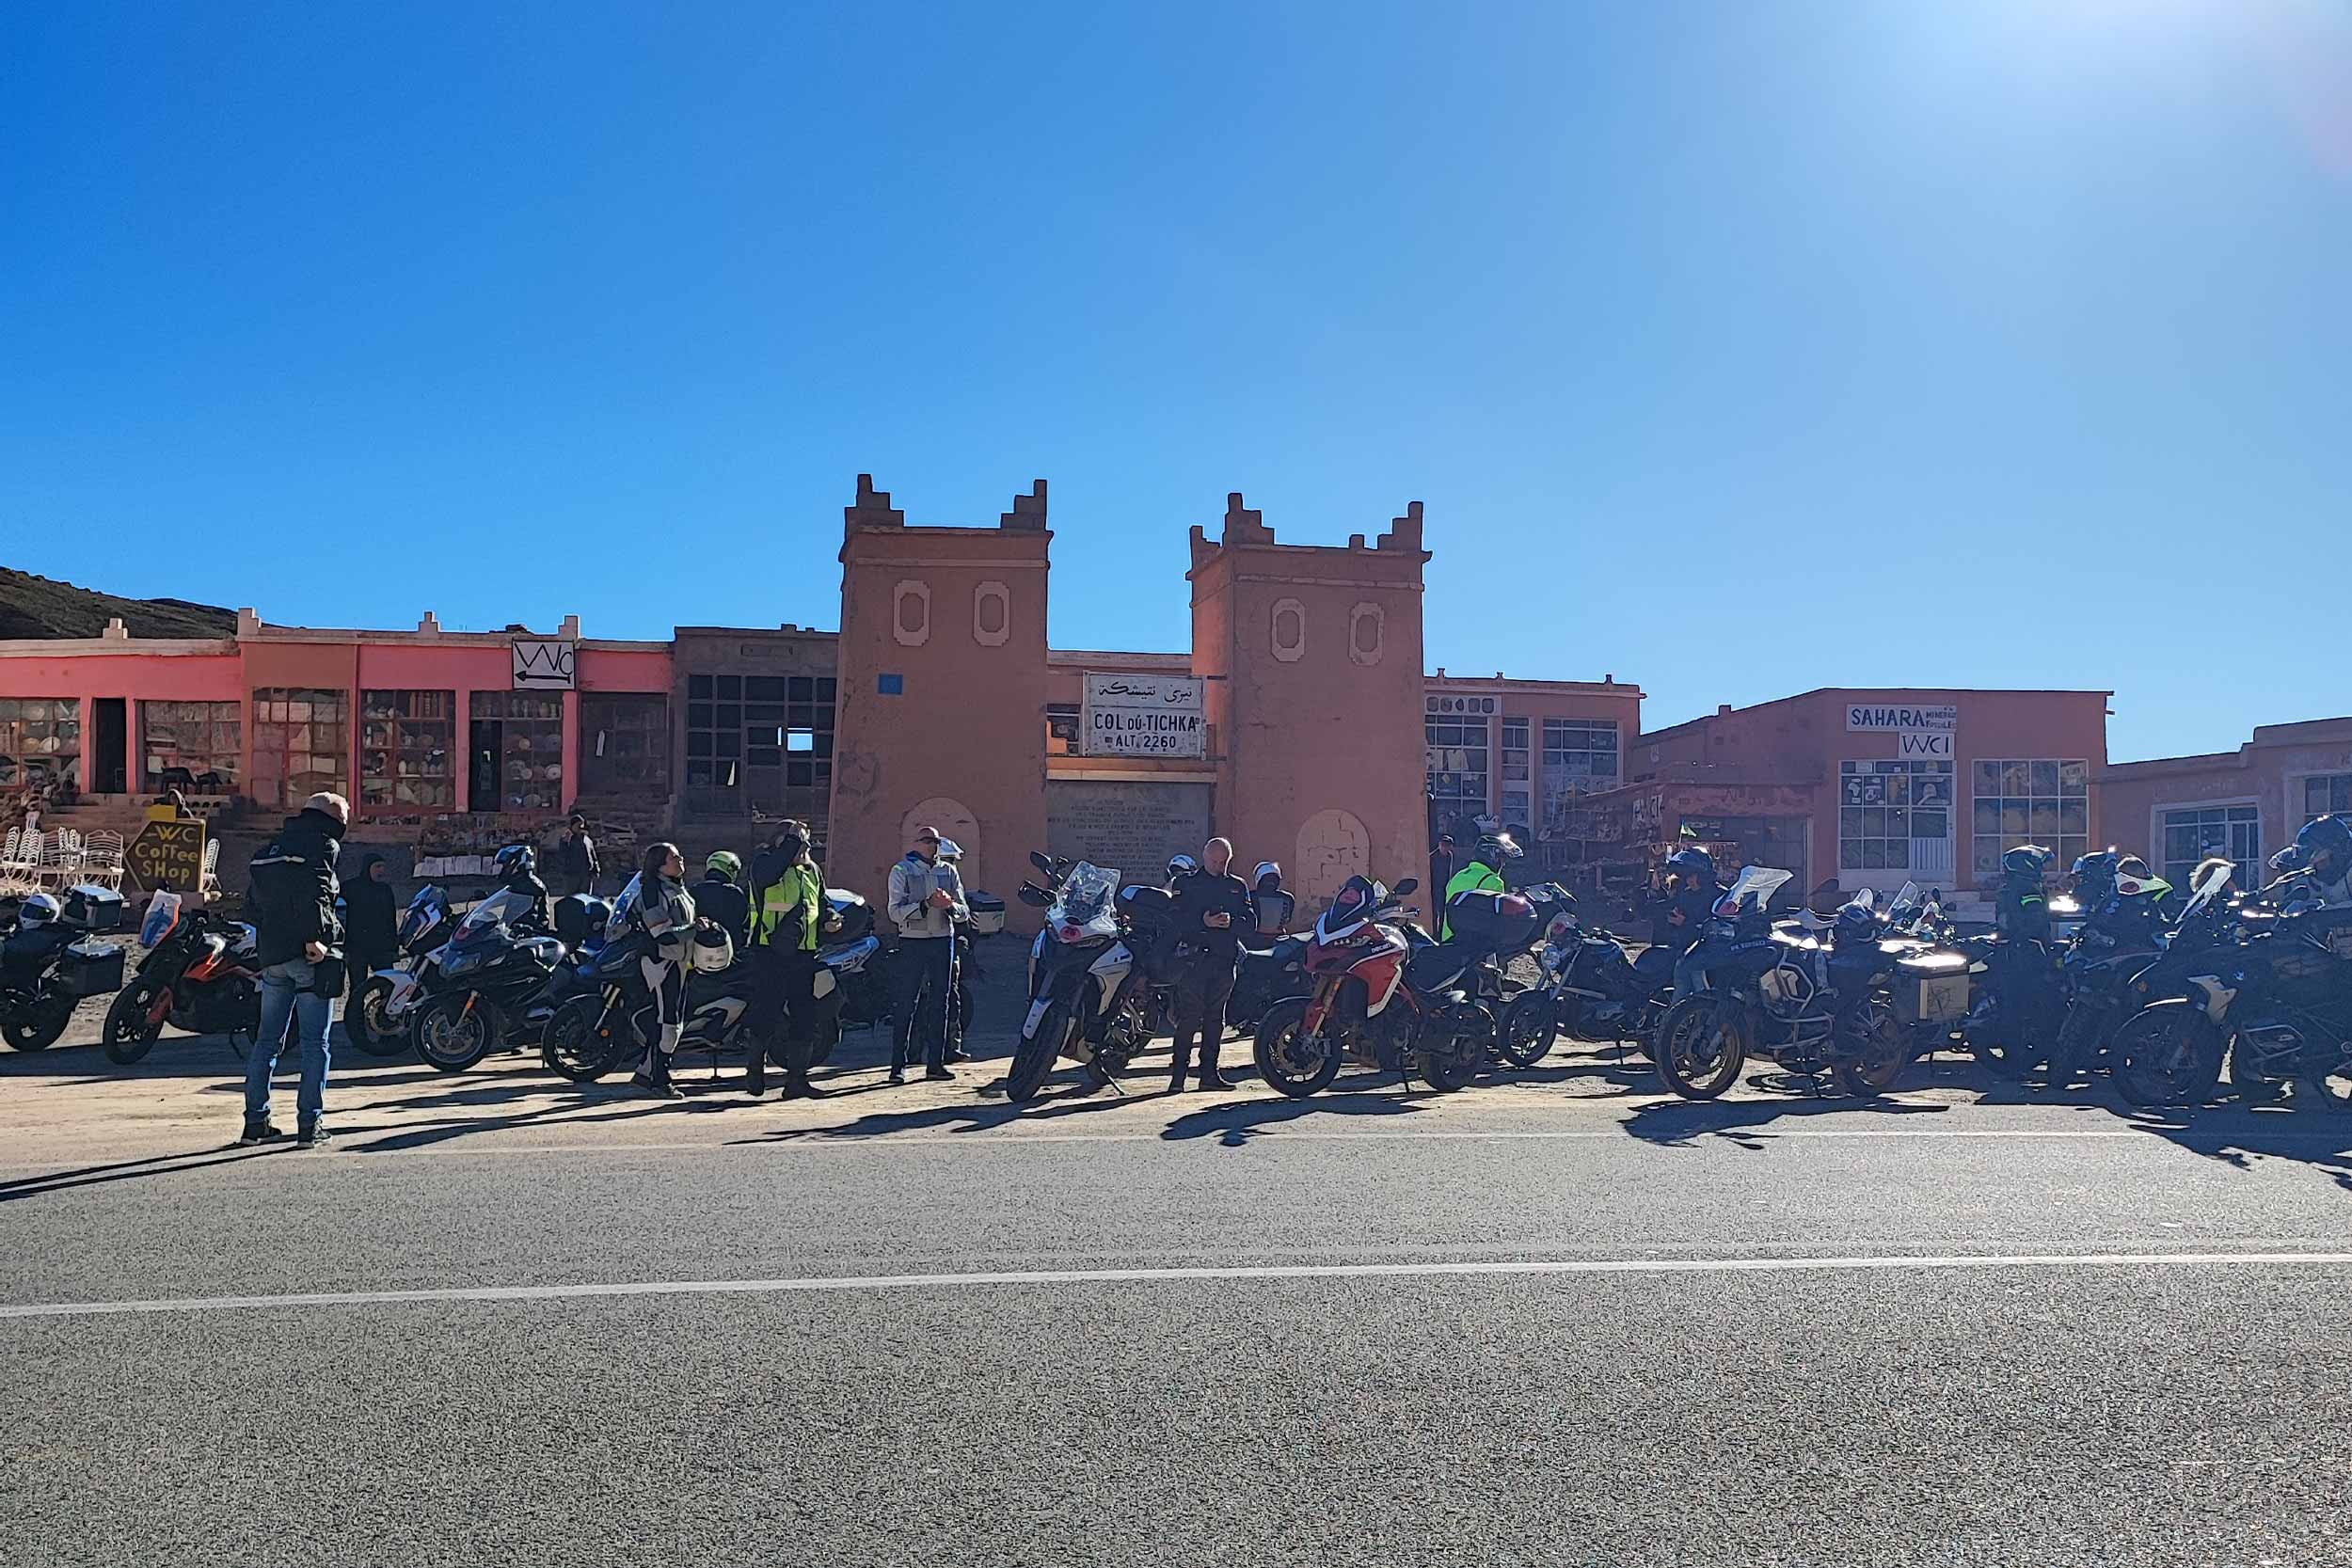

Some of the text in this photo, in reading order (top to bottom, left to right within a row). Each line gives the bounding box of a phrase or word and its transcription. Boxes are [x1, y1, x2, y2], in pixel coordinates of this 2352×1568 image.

[514, 642, 573, 675] WC
[1094, 713, 1124, 731] COL
[1146, 714, 1197, 733] TICHKA
[1851, 708, 1925, 727] SAHARA
[1143, 735, 1177, 749] 2260
